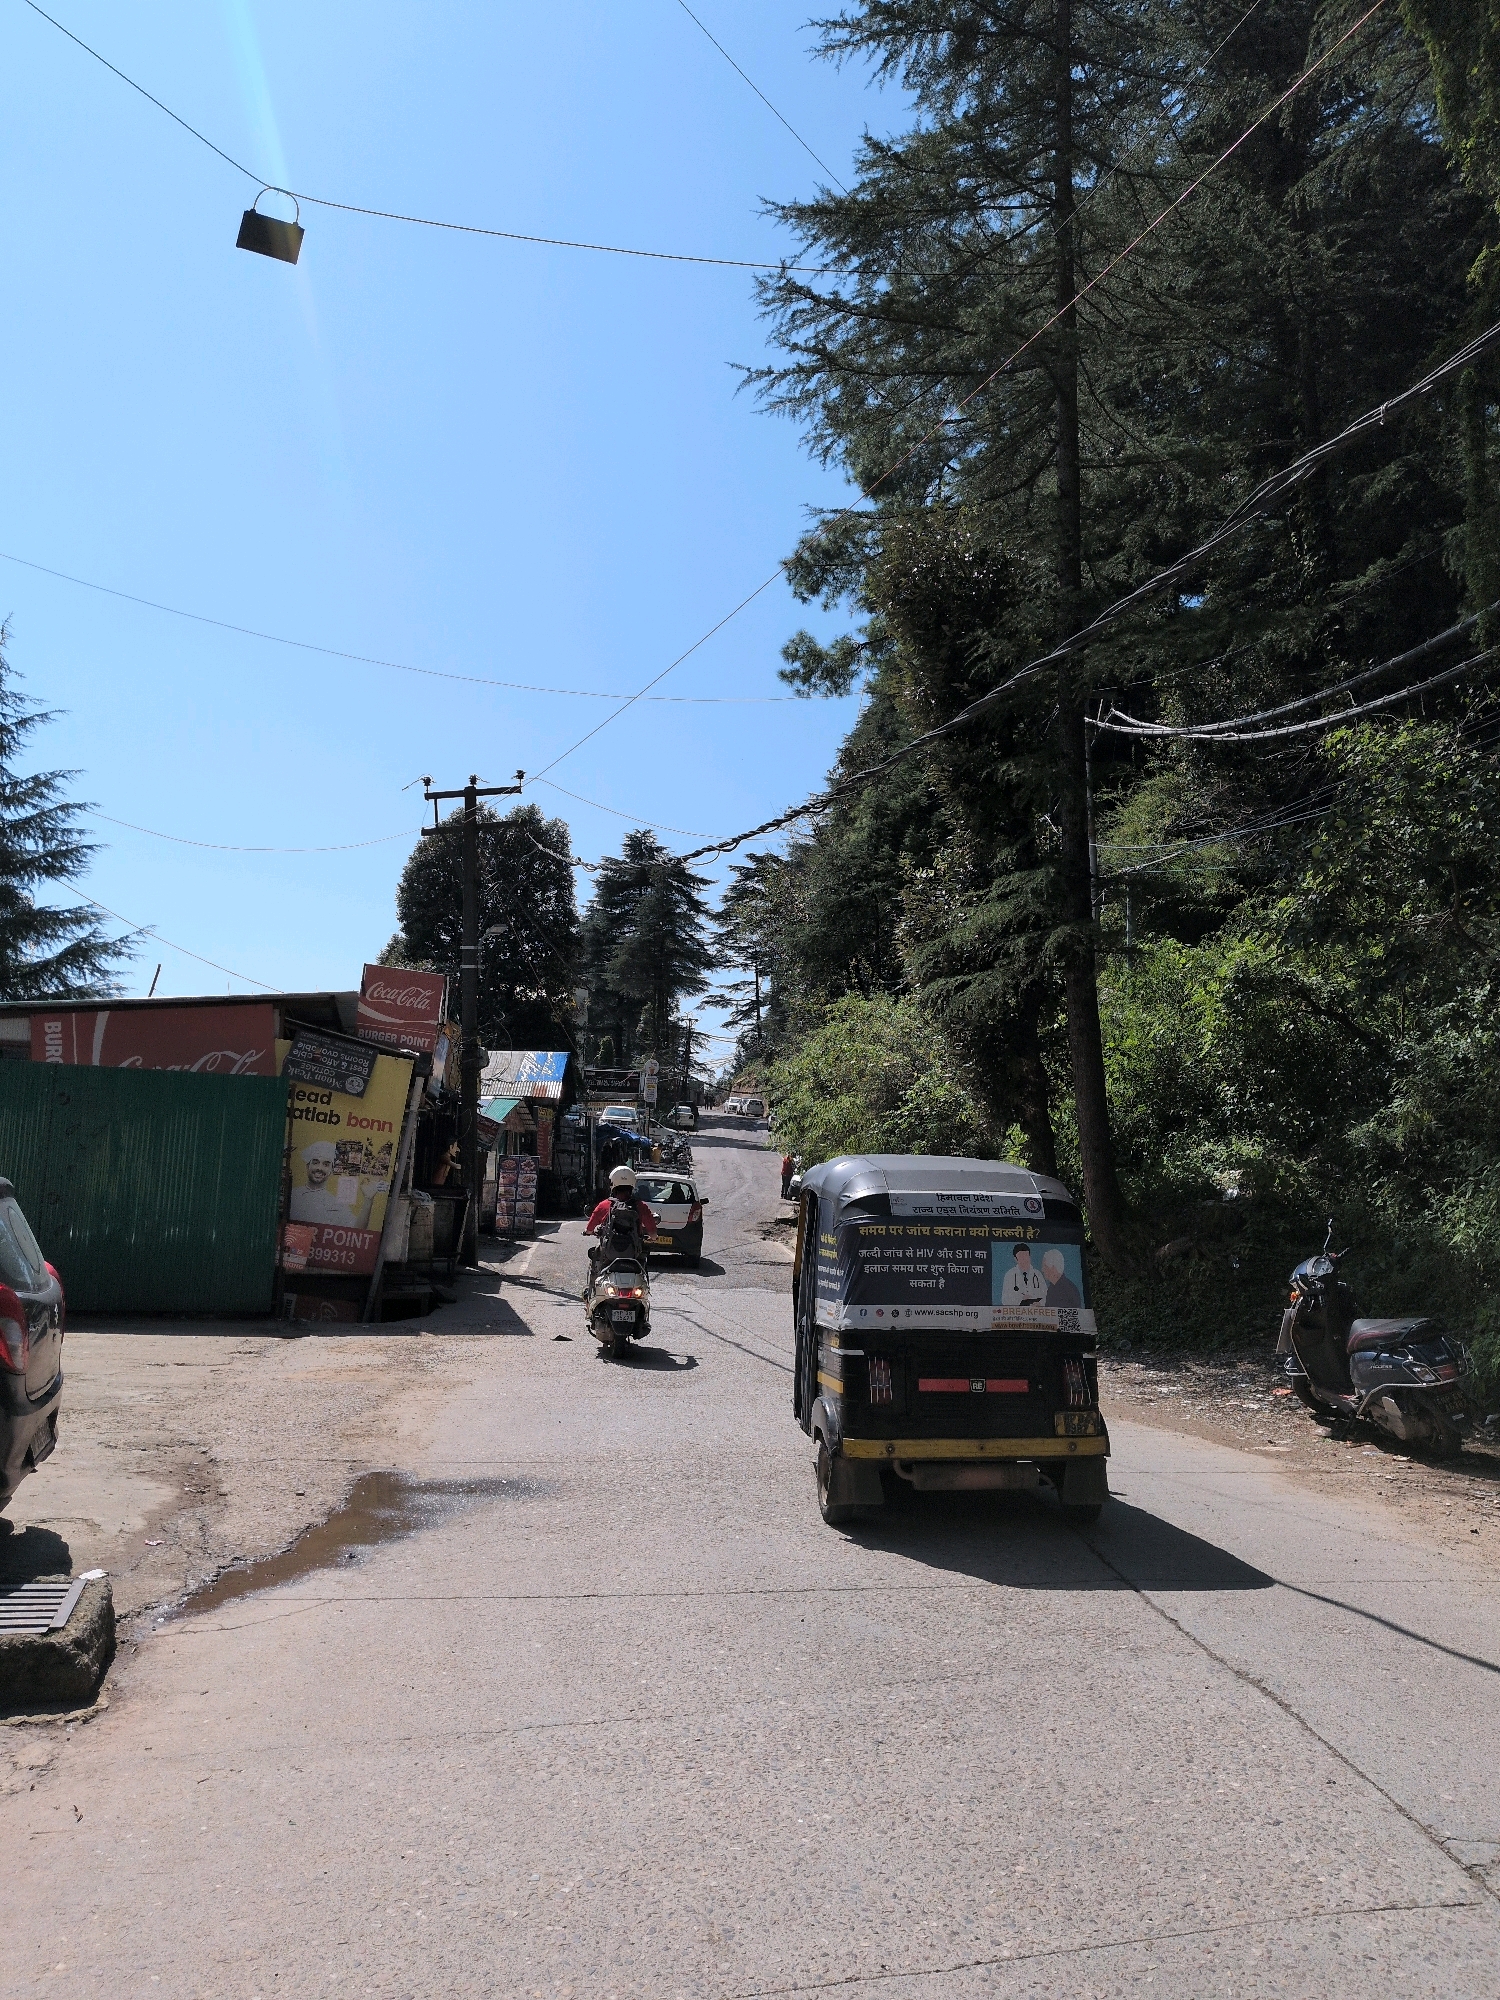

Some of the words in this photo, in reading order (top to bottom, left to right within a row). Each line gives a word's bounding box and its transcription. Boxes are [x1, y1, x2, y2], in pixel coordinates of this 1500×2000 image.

[366, 982, 435, 1010] Coca-Cola
[358, 1028, 398, 1044] BURGER
[400, 1034, 431, 1048] POINT
[340, 1053, 370, 1067] Rooms
[341, 1061, 348, 1070] &
[287, 1063, 313, 1081] Peak
[300, 1062, 336, 1077] COTTAGE
[350, 1063, 369, 1076] Best
[315, 1073, 343, 1089] Moon
[288, 1088, 333, 1105] ead
[346, 1111, 393, 1133] bonn
[912, 1206, 934, 1214] राज्य
[992, 1205, 1021, 1215] समिति
[859, 1225, 886, 1236] समय
[889, 1225, 904, 1236] पर
[906, 1224, 931, 1236] जांच
[934, 1226, 967, 1237] कराना
[322, 1228, 374, 1250] POINT
[859, 1247, 882, 1258] जल्दी
[883, 1247, 903, 1258] जांच
[905, 1247, 914, 1258] से
[916, 1248, 935, 1258] HIV
[937, 1248, 954, 1259] और
[956, 1249, 972, 1259] STI
[975, 1250, 988, 1259] का
[864, 1264, 890, 1274] इलाज
[892, 1264, 915, 1274] समय
[916, 1265, 928, 1274] पर
[948, 1262, 970, 1274] किया
[972, 1265, 985, 1274] जा
[909, 1279, 937, 1289] सकता
[938, 1277, 946, 1290] है
[914, 1308, 979, 1320] www.sacshporg
[1002, 1307, 1057, 1317] BREAKFREE
[972, 1382, 983, 1391] RE
